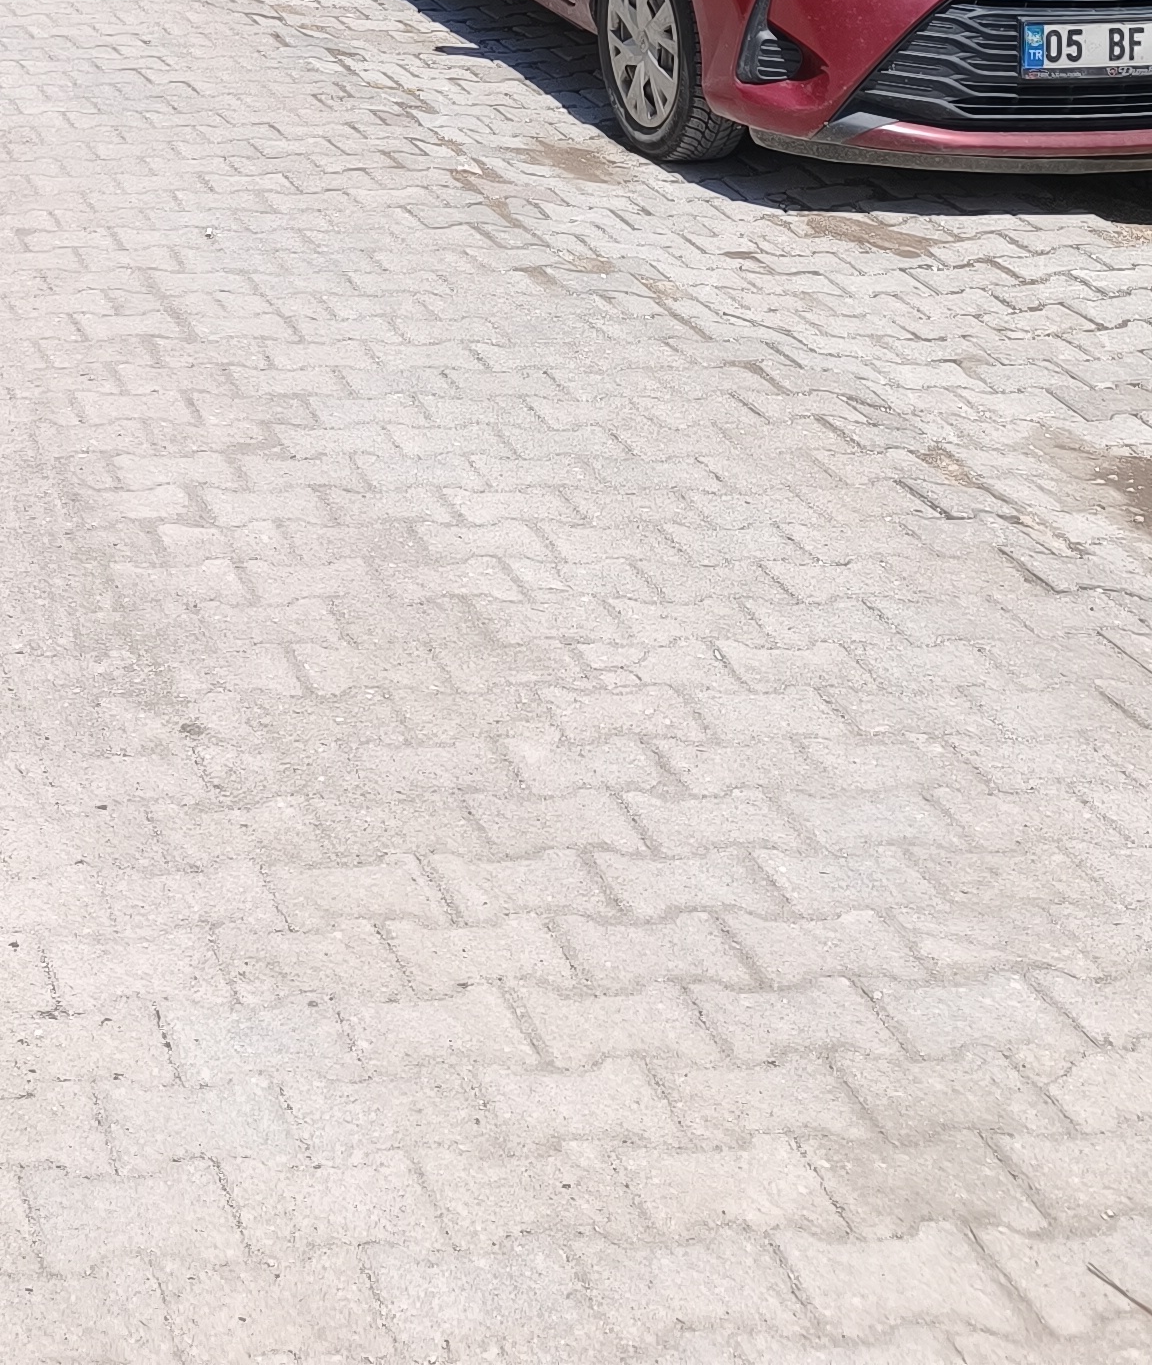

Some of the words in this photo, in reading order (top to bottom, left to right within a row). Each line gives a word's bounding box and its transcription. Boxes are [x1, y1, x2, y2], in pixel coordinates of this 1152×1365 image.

[1029, 50, 1043, 60] TR
[1045, 29, 1083, 63] 05
[1109, 27, 1145, 61] BF
